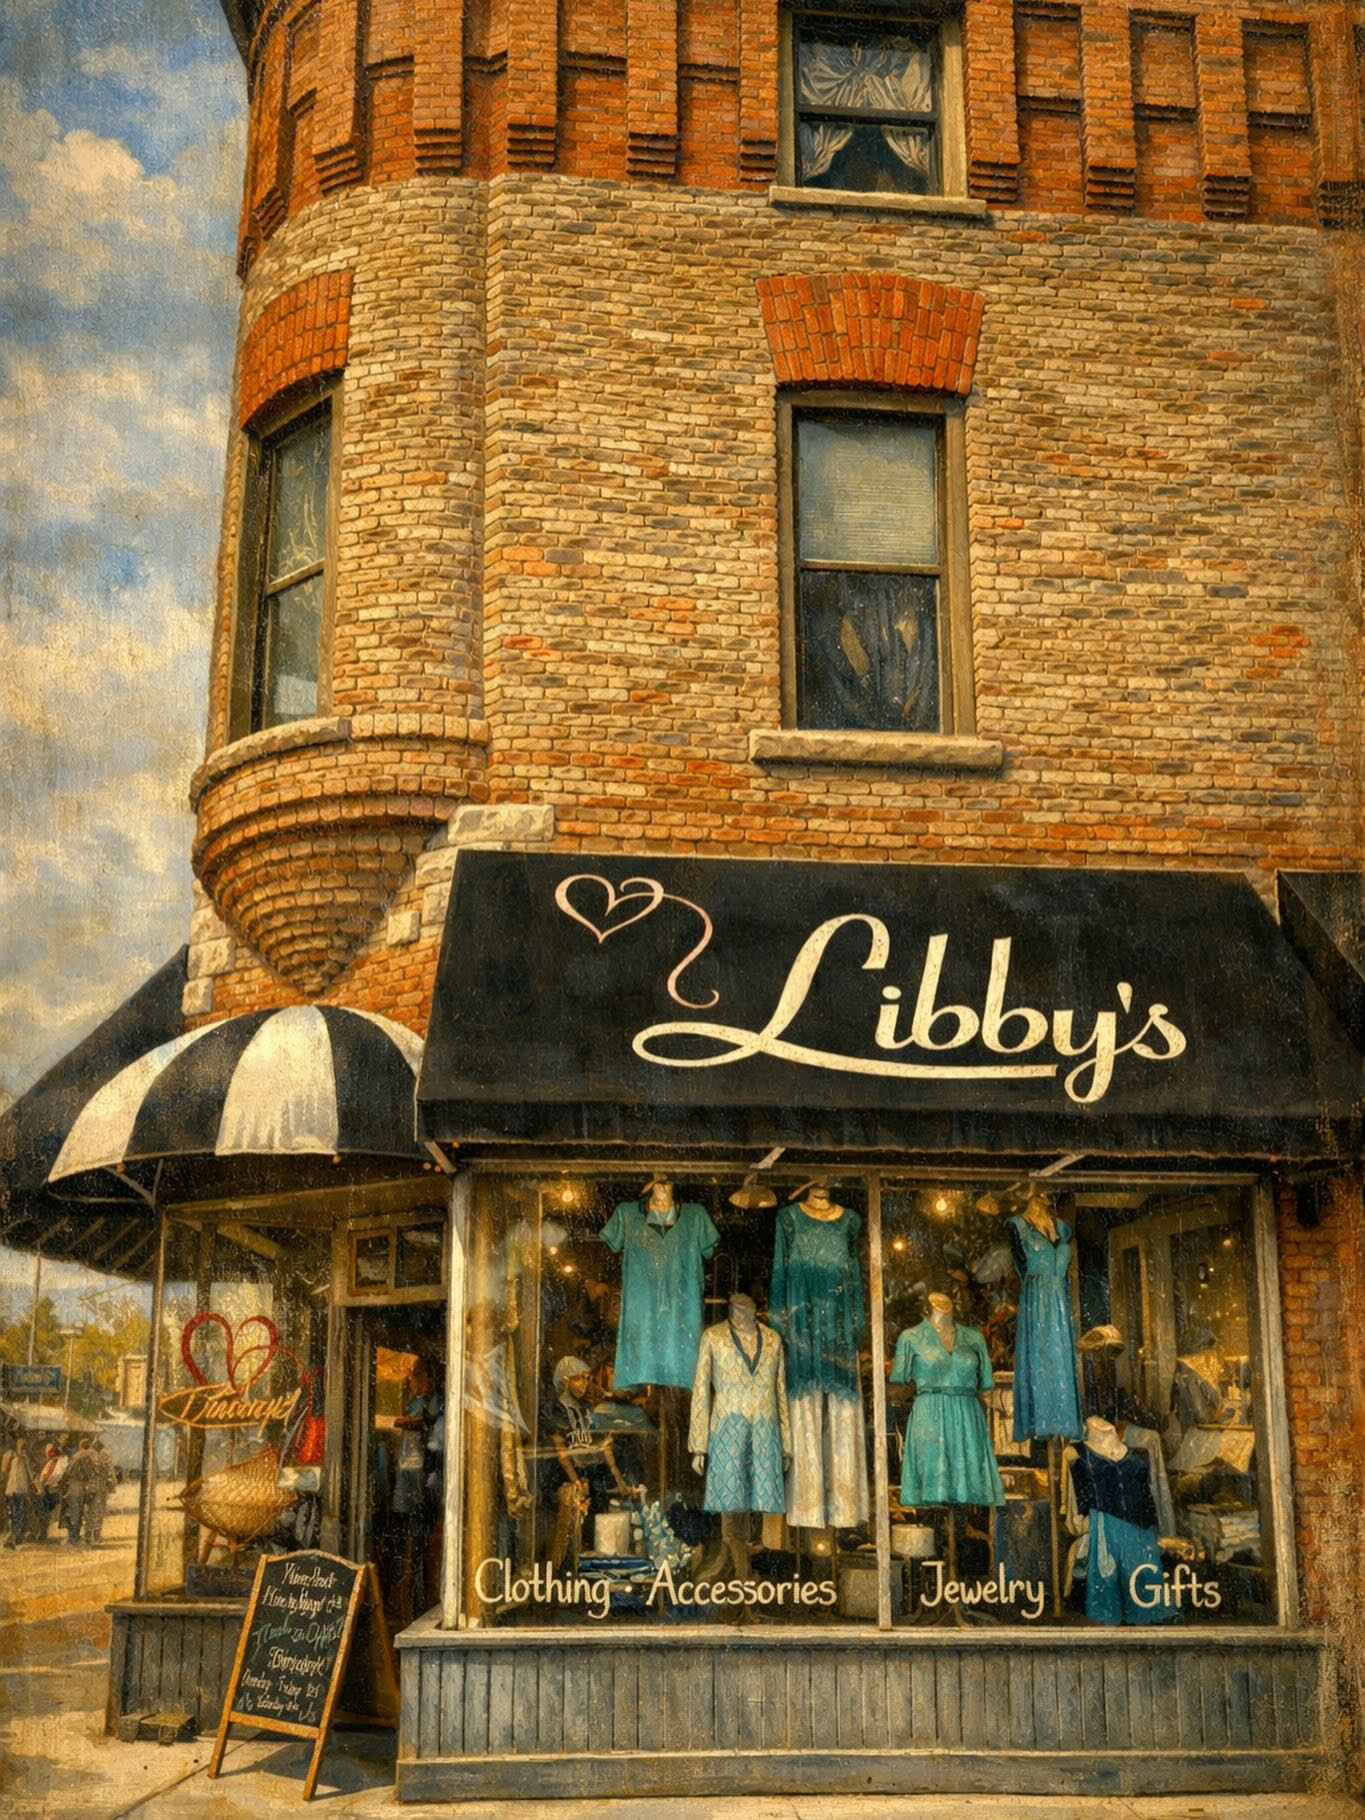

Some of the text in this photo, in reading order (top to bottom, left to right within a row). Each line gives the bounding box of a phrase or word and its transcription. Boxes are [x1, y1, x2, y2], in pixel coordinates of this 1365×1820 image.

[632, 914, 1185, 1104] Libby's
[475, 1558, 838, 1620] Clothing Accessories
[920, 1561, 1222, 1619] Jewelry Gifts
